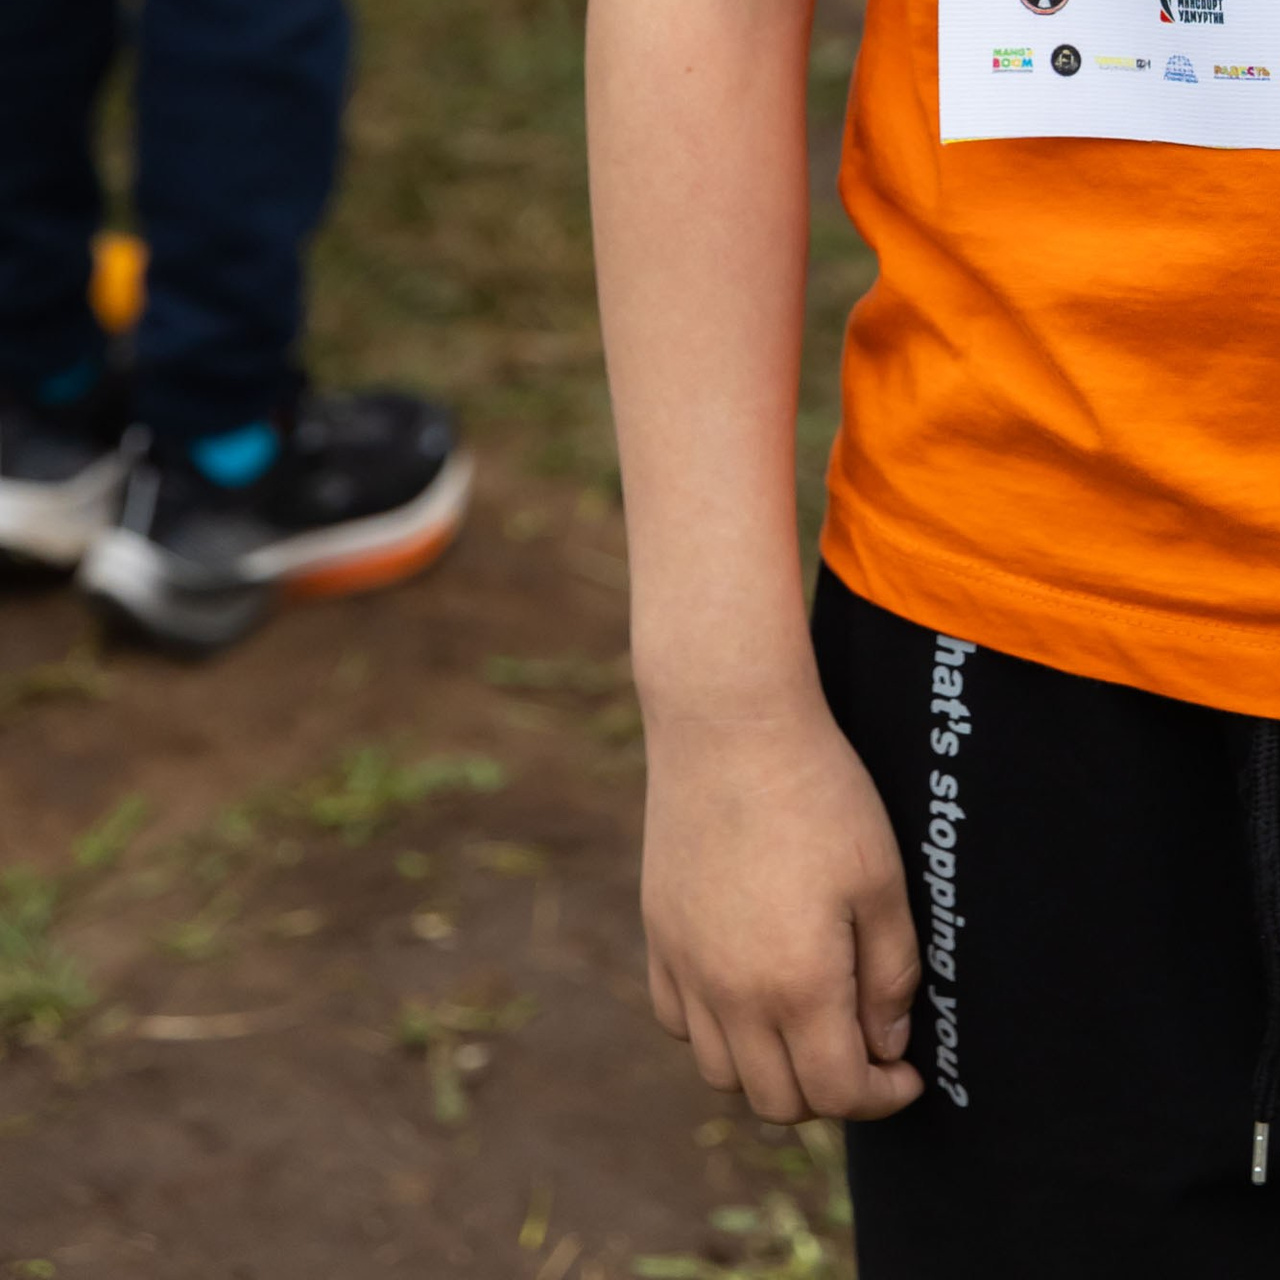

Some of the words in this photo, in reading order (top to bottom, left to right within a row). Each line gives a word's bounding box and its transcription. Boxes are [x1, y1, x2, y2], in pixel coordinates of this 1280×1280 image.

[1178, 10, 1224, 25] УДМУРТИИ
[927, 632, 978, 757] hat's
[921, 769, 966, 981] stopping
[928, 984, 968, 1108] you?
